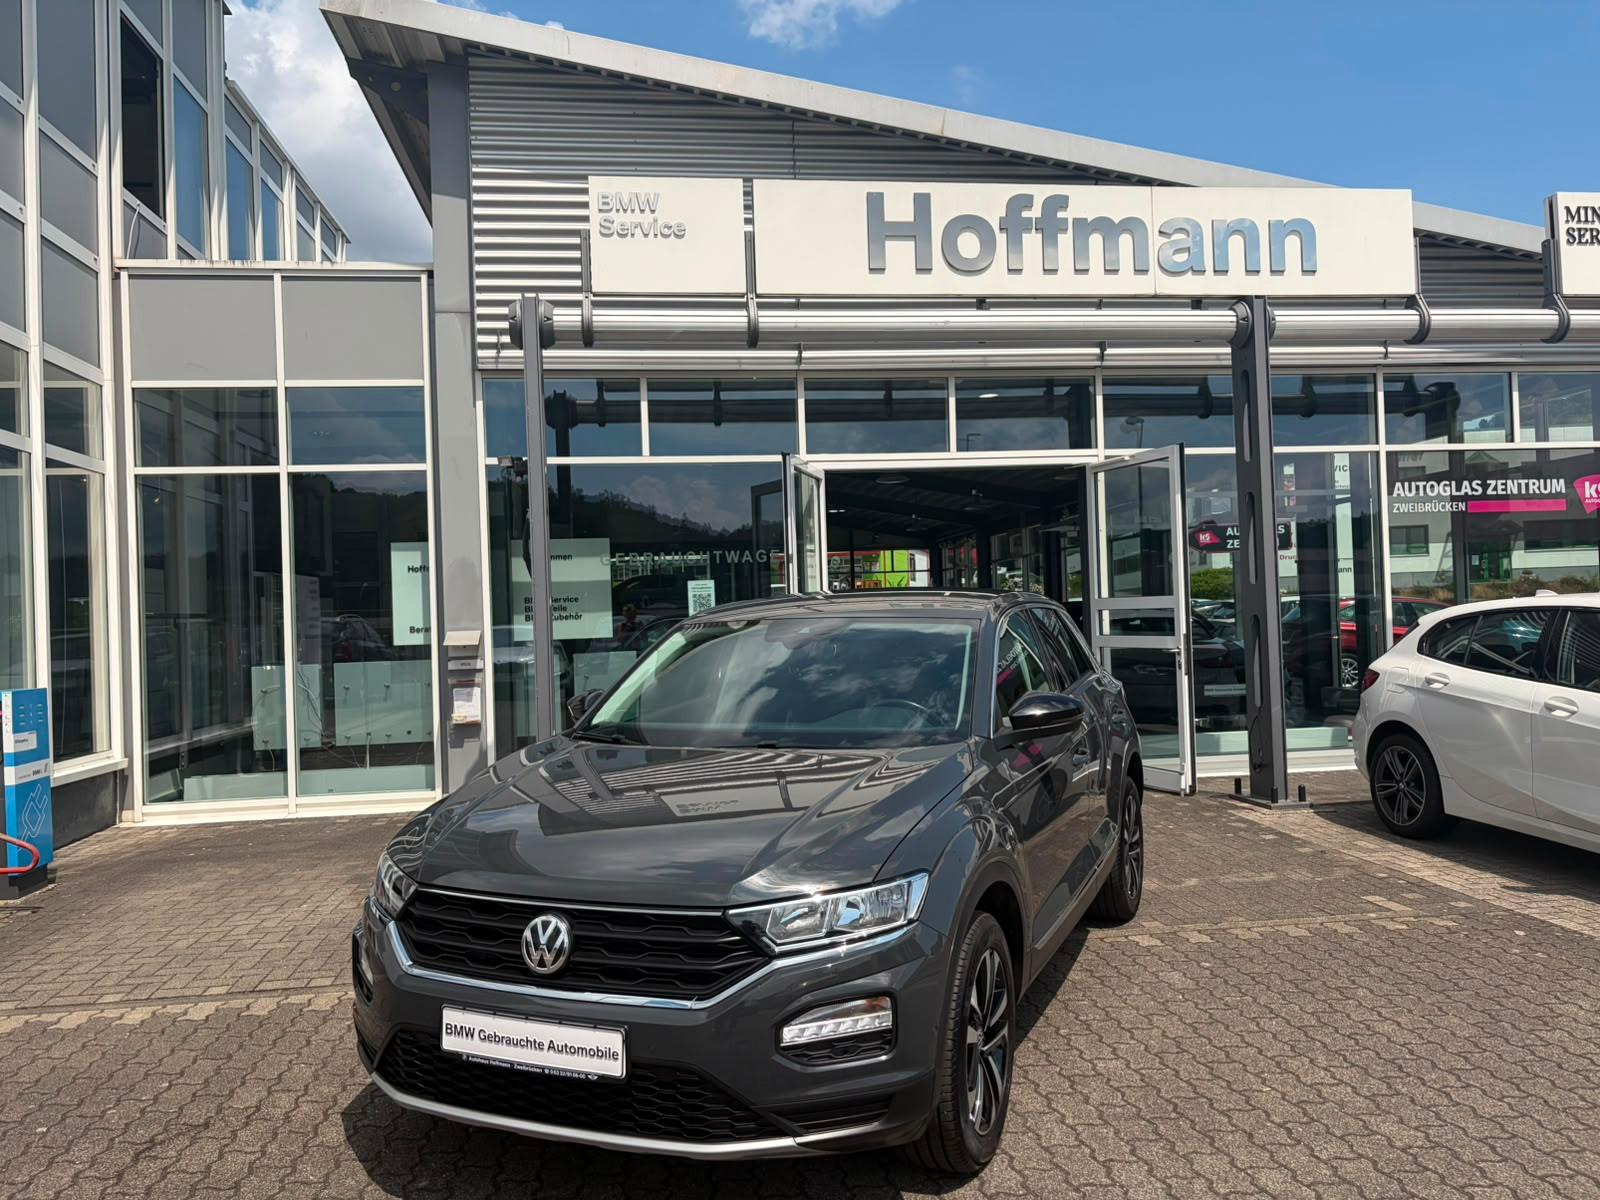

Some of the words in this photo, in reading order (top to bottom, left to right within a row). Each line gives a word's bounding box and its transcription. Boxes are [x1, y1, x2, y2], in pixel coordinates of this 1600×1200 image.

[597, 190, 660, 214] BMW
[1564, 205, 1600, 225] MIN
[598, 215, 687, 239] Service
[866, 191, 1318, 274] Hoffmann
[1566, 227, 1600, 247] SER
[1392, 480, 1483, 497] AUTOGLAS
[1486, 478, 1566, 495] ZENTRUM
[1392, 501, 1467, 513] ZWEIBRÜCKEN
[600, 549, 781, 567] GEBRAUCHTWAGE
[407, 565, 430, 574] Hoff
[409, 625, 431, 634] Bera
[445, 1022, 475, 1039] BMW
[478, 1028, 545, 1051] Gebrauchte
[547, 1039, 619, 1061] Automobile
